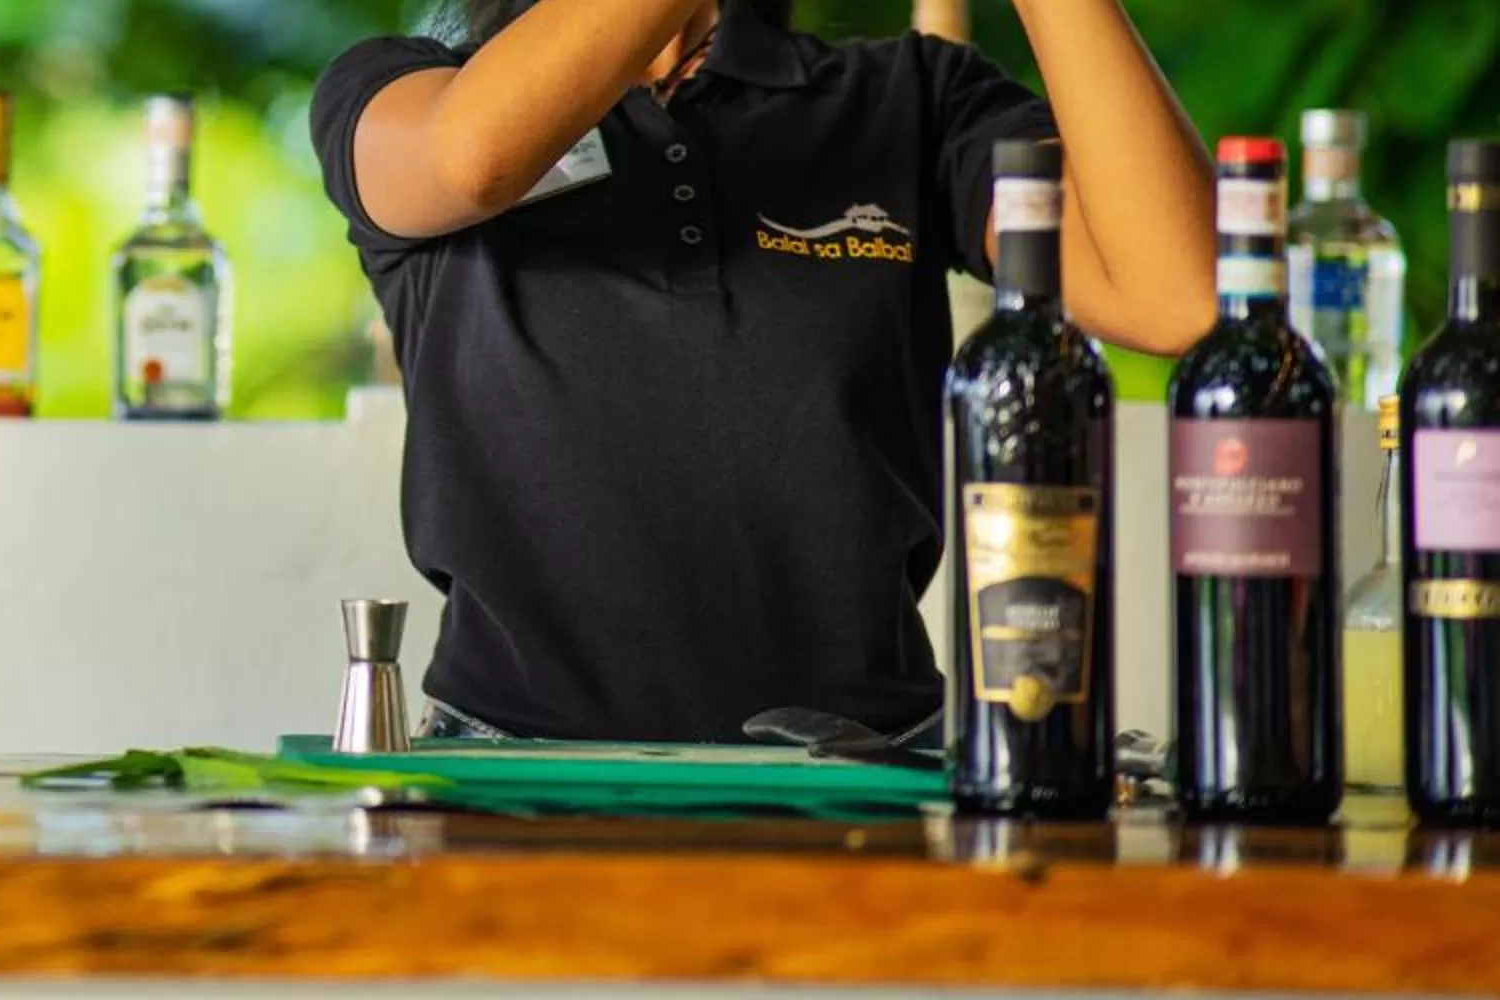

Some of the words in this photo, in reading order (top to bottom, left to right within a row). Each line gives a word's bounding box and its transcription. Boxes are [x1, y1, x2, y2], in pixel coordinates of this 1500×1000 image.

[755, 230, 810, 256] Balai
[813, 242, 842, 259] sa
[845, 235, 914, 263] Balbai
